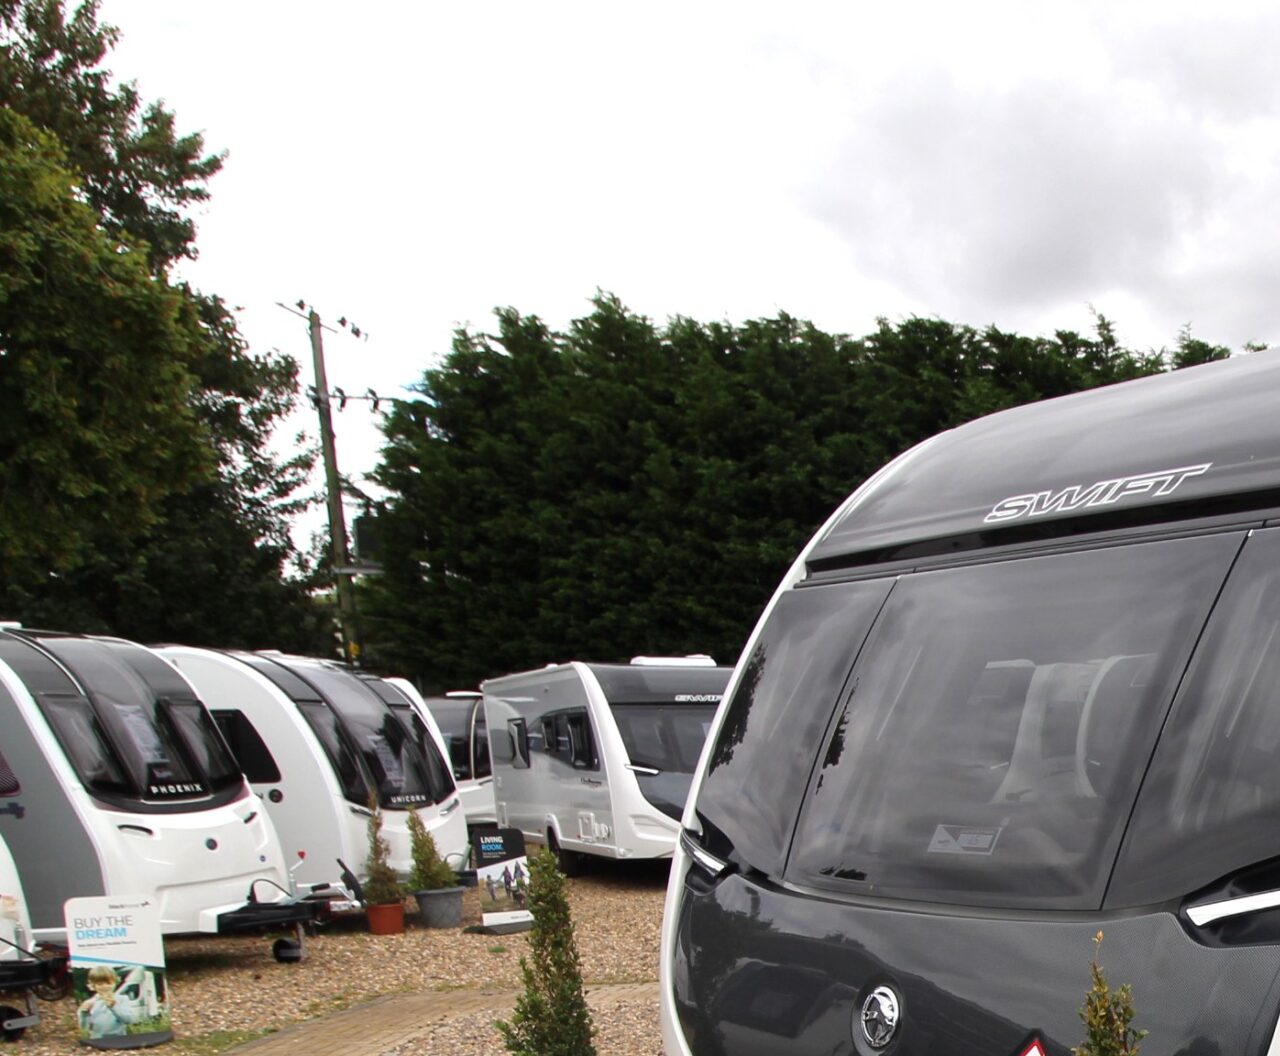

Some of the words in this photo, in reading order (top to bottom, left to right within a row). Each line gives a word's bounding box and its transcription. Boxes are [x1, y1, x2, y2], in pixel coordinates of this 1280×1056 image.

[983, 462, 1213, 523] SWIFT
[150, 783, 203, 794] PHOENIX
[391, 794, 426, 803] UNICORN
[74, 918, 102, 928] BUY
[105, 915, 133, 926] THE
[75, 928, 127, 940] DREAM
